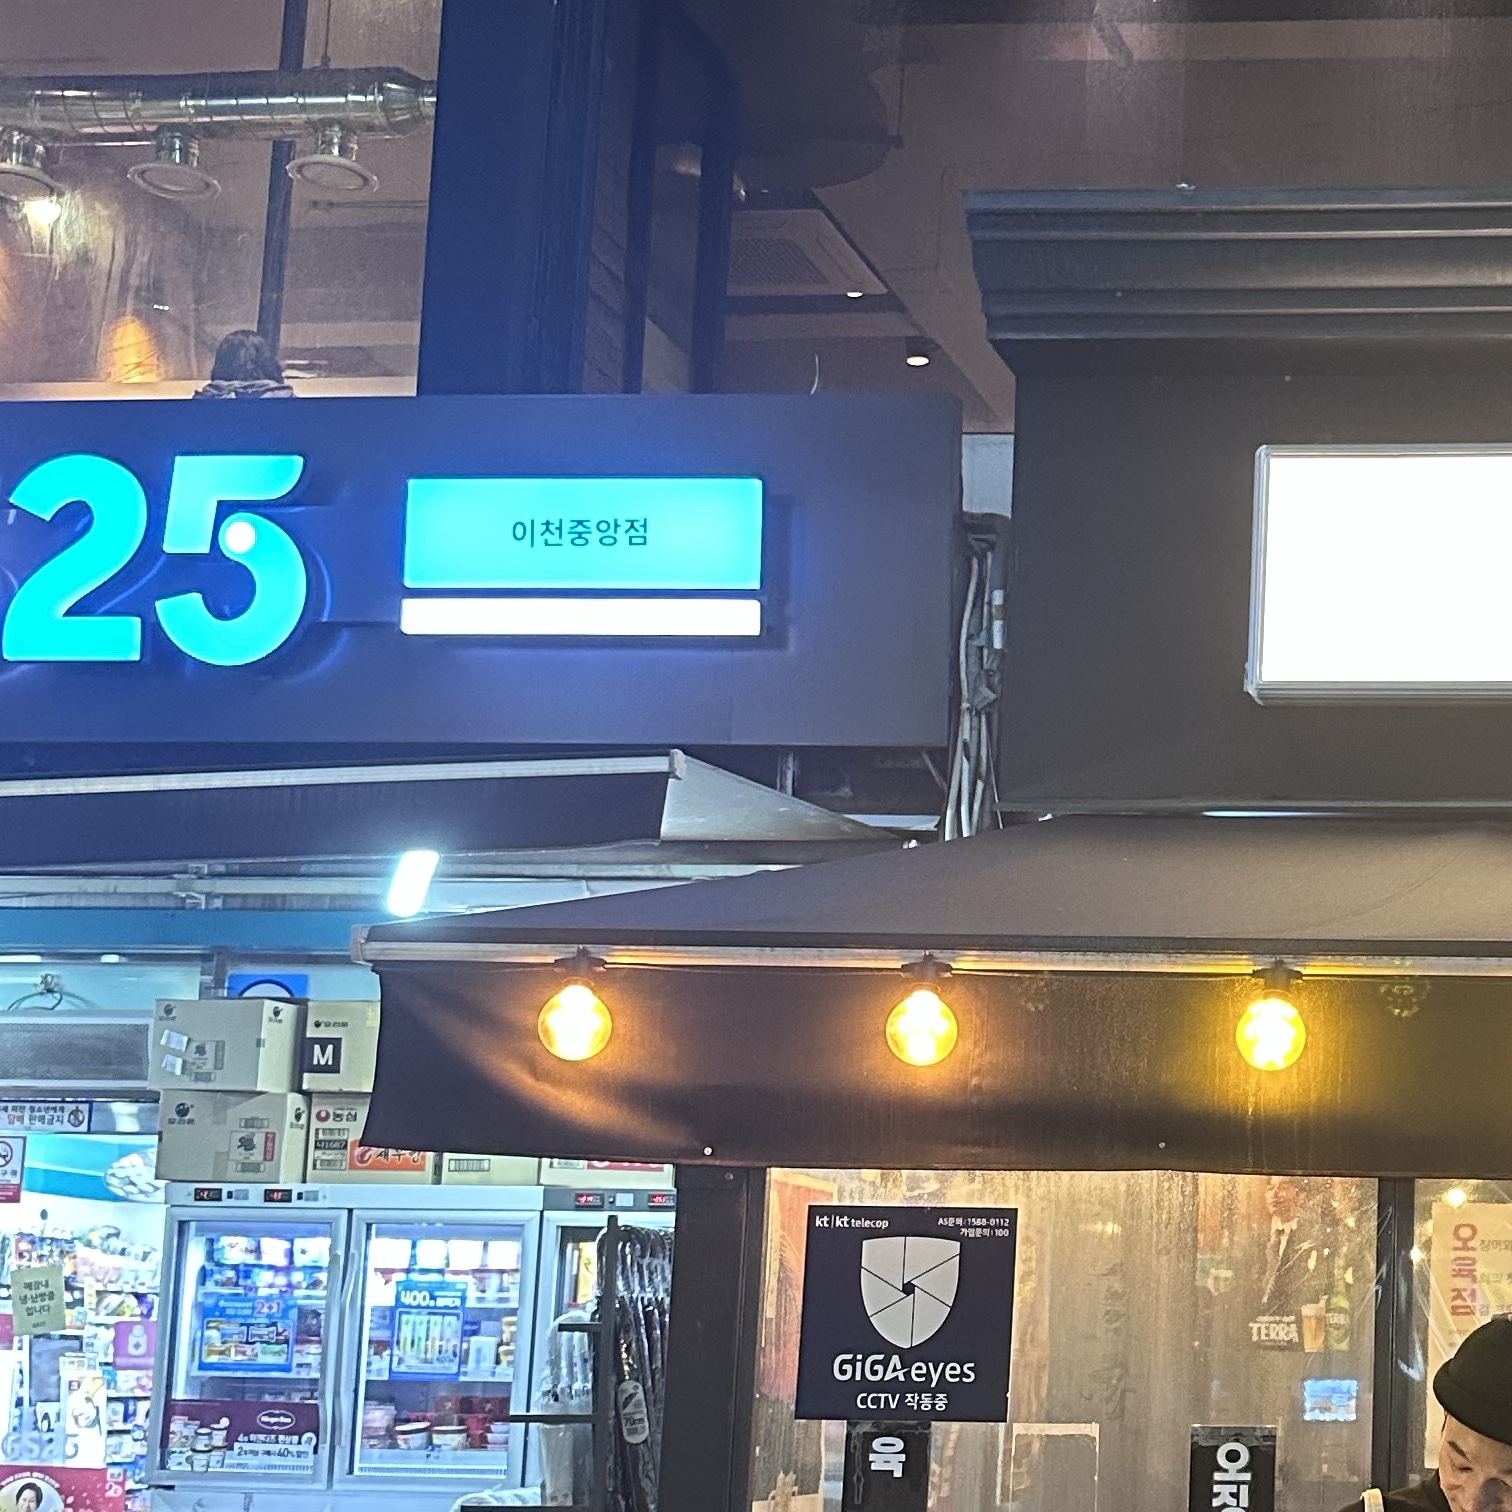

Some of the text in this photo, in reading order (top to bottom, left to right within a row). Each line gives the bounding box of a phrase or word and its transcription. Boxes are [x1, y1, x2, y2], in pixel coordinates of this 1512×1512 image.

[511, 516, 650, 548] 이천중앙점
[2, 454, 307, 667] 25
[313, 1045, 333, 1065] M
[332, 1111, 358, 1122] 농심
[815, 1215, 888, 1230] kt kt telecop
[1249, 1322, 1299, 1343] TERRA
[856, 1393, 949, 1411] CCTV 작동중
